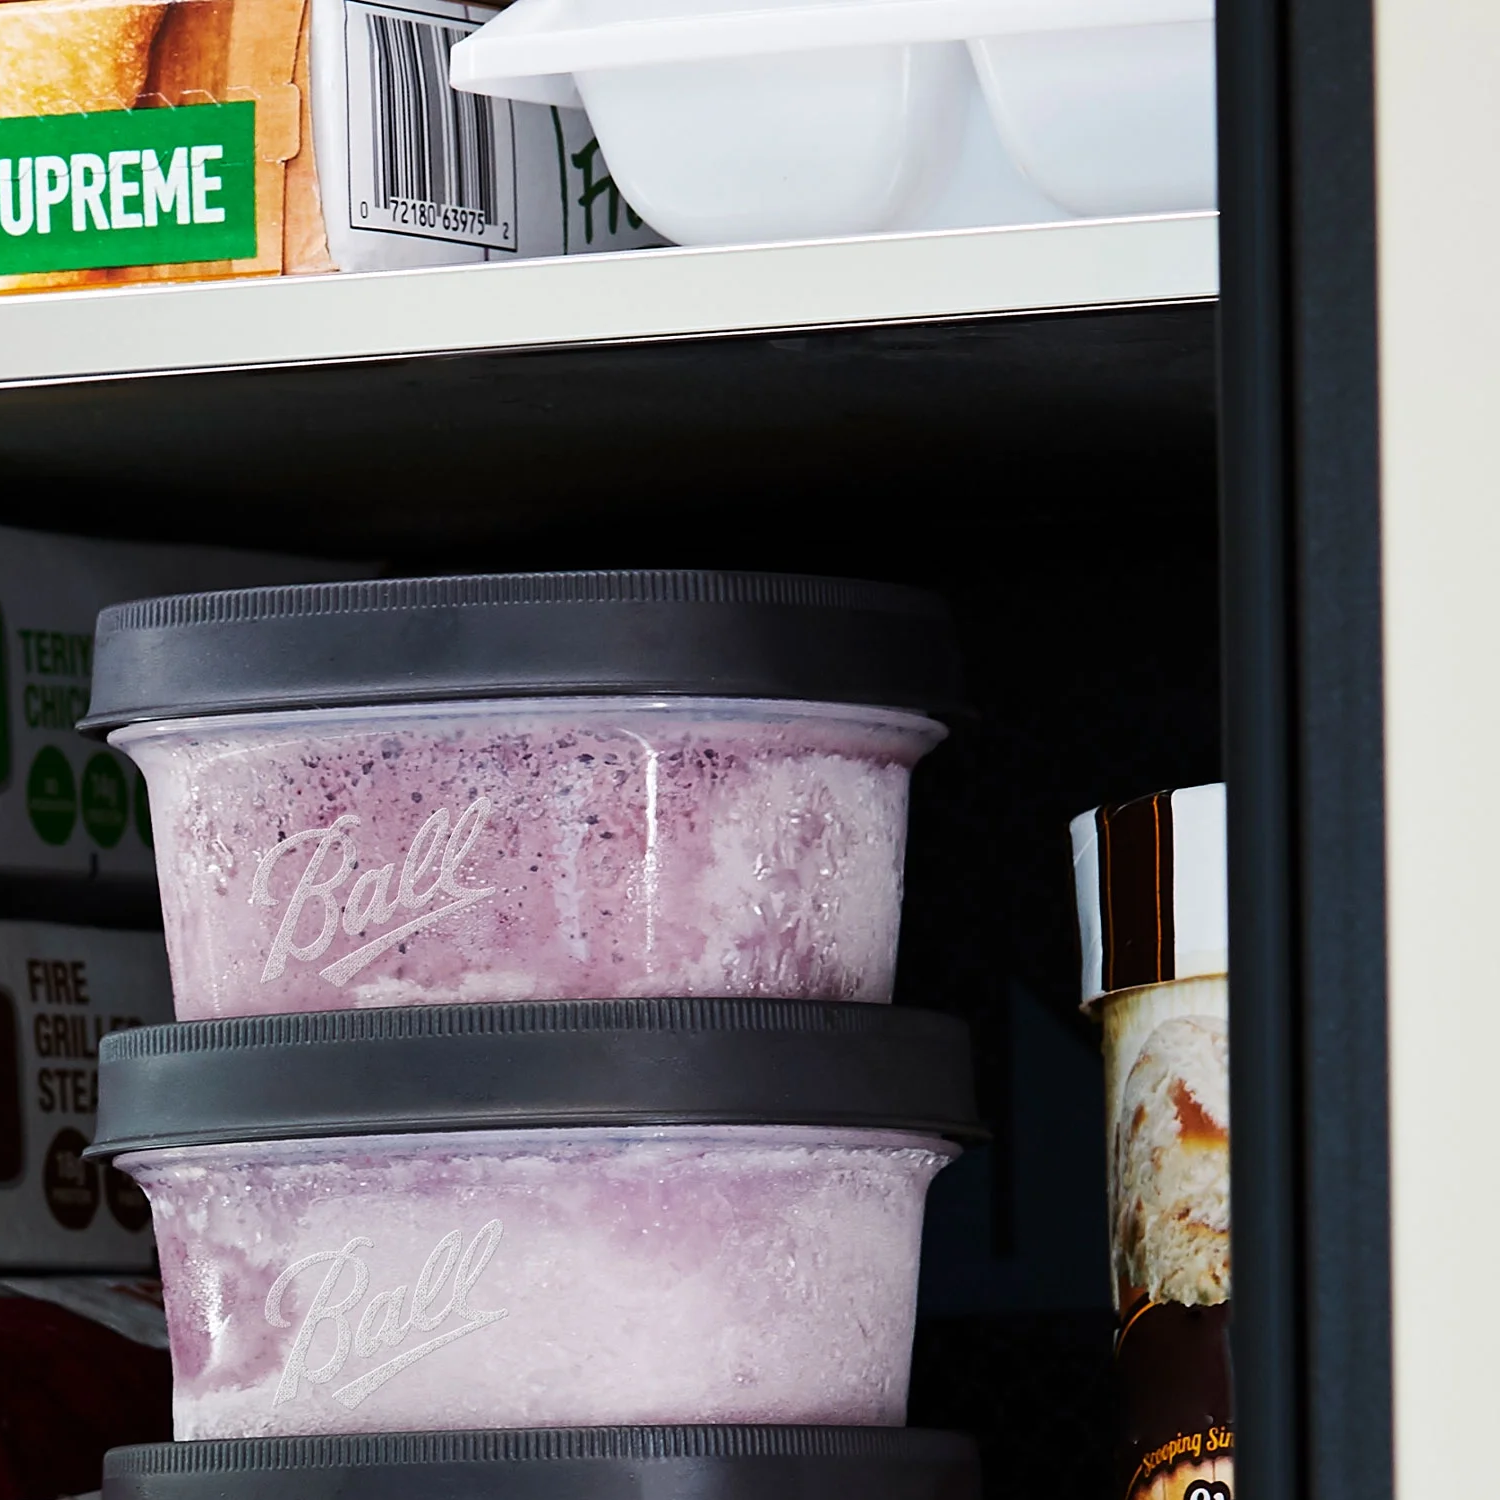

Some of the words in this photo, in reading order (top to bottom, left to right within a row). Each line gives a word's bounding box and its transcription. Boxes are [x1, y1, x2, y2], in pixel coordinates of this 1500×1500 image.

[359, 200, 370, 219] 0
[389, 199, 437, 229] 72180
[442, 207, 486, 236] 63975
[502, 222, 510, 240] 2
[253, 797, 496, 987] Ball
[27, 959, 90, 1006] FIRE
[265, 1219, 509, 1410] Ball
